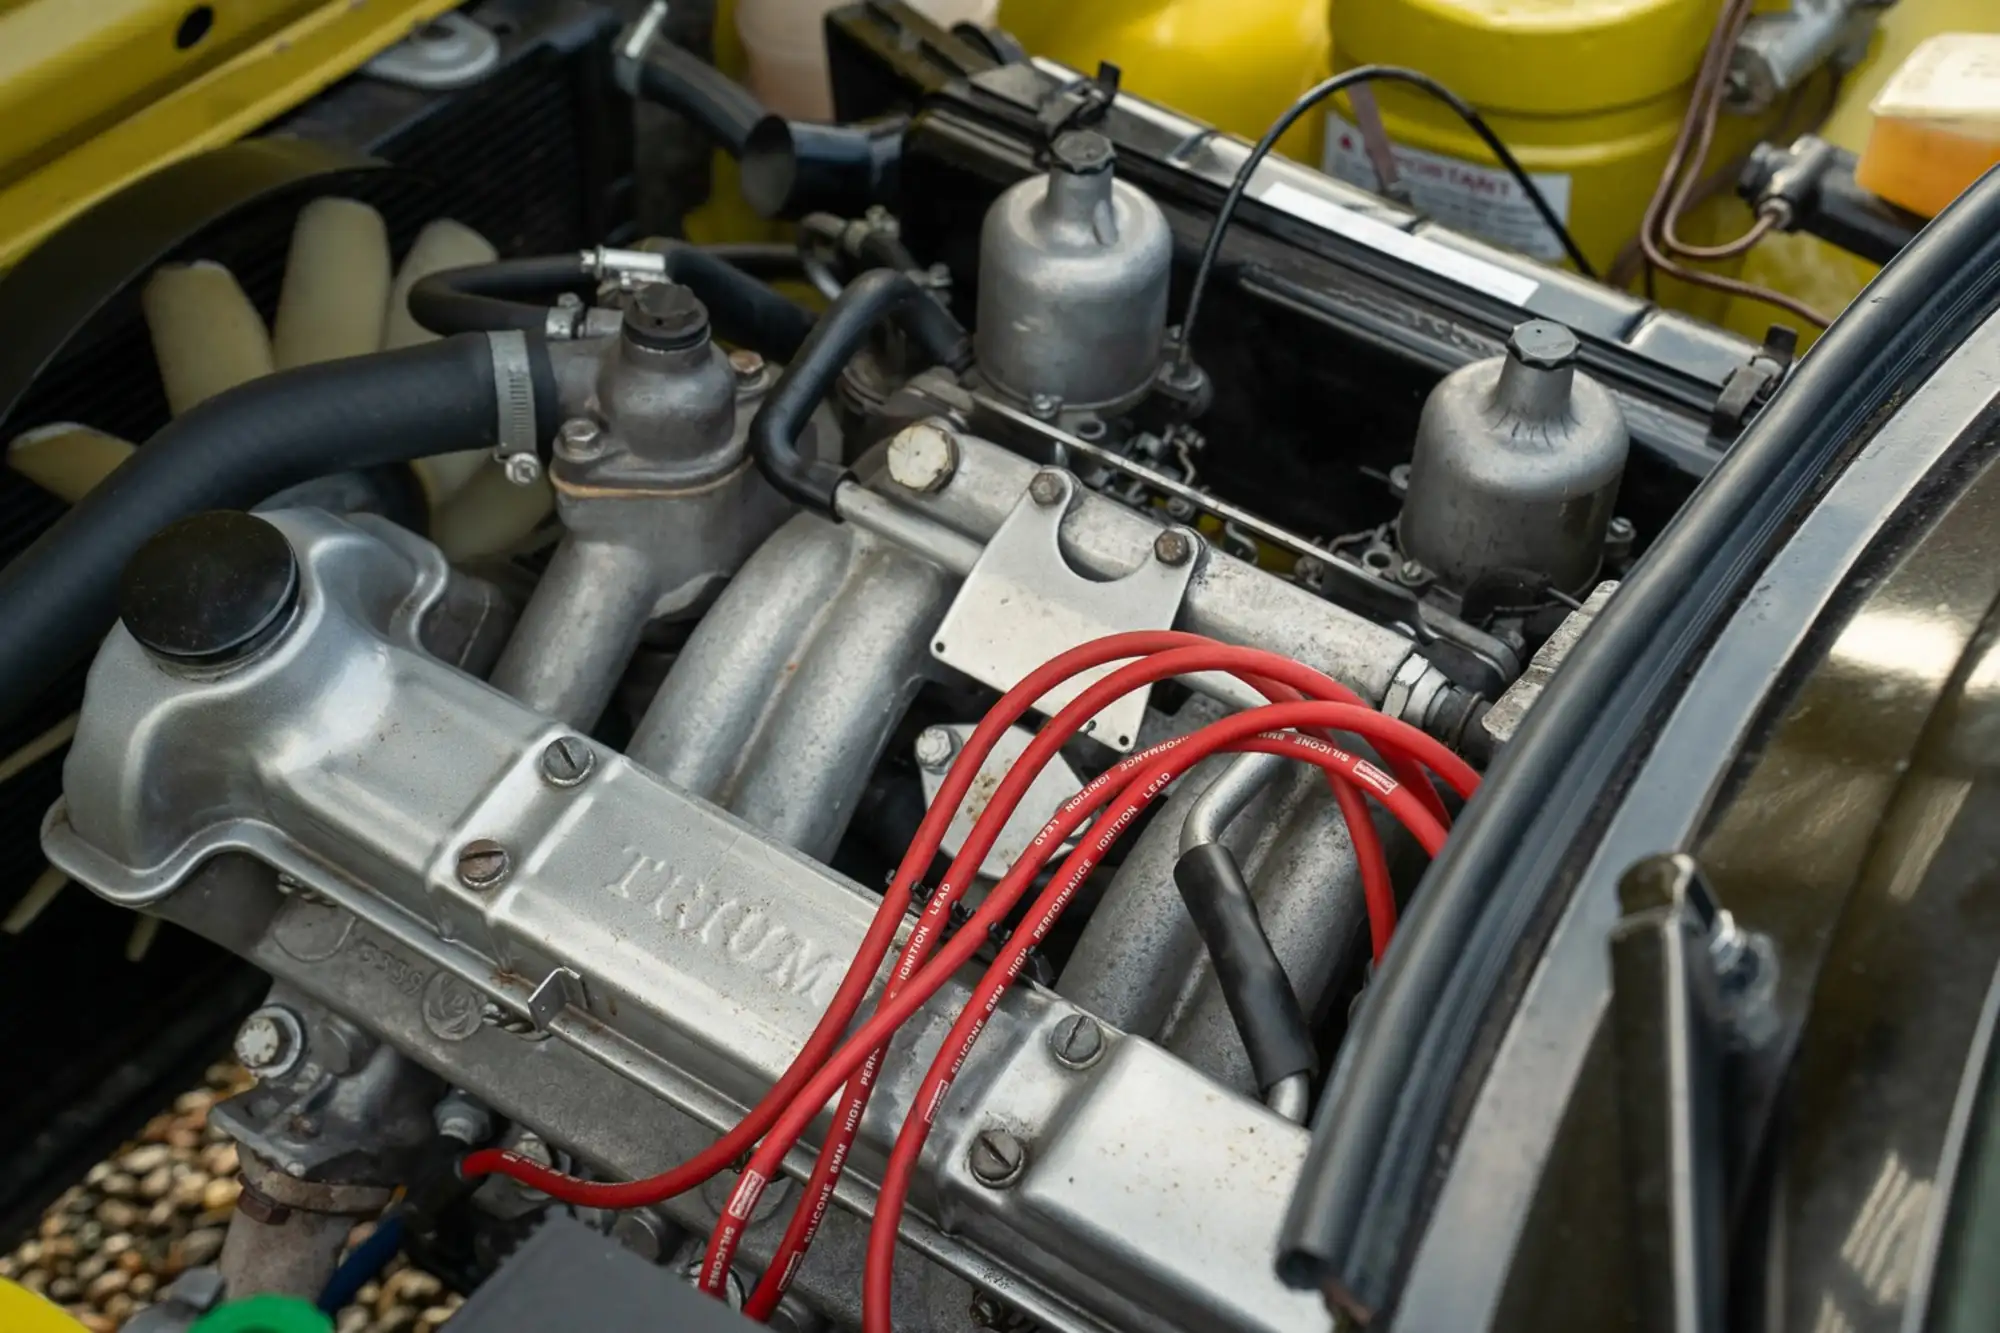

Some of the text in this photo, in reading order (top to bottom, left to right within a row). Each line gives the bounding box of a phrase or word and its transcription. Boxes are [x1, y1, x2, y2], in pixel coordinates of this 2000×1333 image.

[1293, 735, 1351, 763] SILICONE
[1065, 773, 1110, 813] IGNITION
[1034, 818, 1060, 846] LEAD
[898, 882, 951, 981] IGNITION LEAD
[951, 1017, 985, 1074] SILICONE
[985, 983, 1005, 1012] 8MM
[1032, 858, 1093, 940] PERFORMANCE
[1096, 804, 1138, 851] IGNITION
[1142, 772, 1171, 799] LEAD
[804, 1098, 862, 1243] SILICONE 8MM HIGH
[707, 1225, 736, 1289] SILICONE
